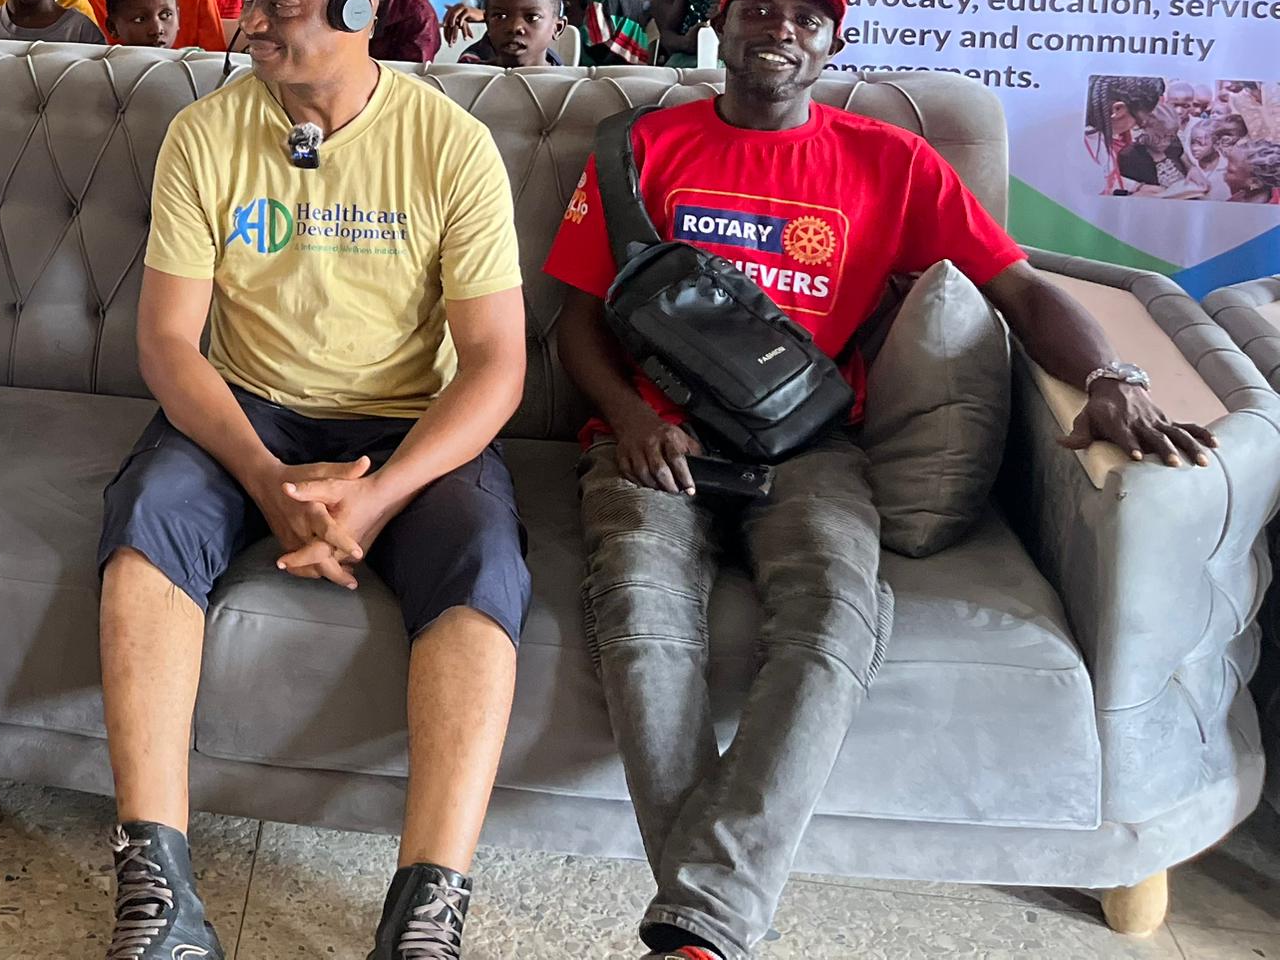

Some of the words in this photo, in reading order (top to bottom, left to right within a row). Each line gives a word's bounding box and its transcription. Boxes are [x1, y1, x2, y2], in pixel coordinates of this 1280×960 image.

[843, 20, 952, 52] elivery
[959, 25, 1018, 50] and
[1026, 30, 1215, 62] community
[297, 202, 408, 225] Healthcare
[683, 214, 773, 242] ROTARY
